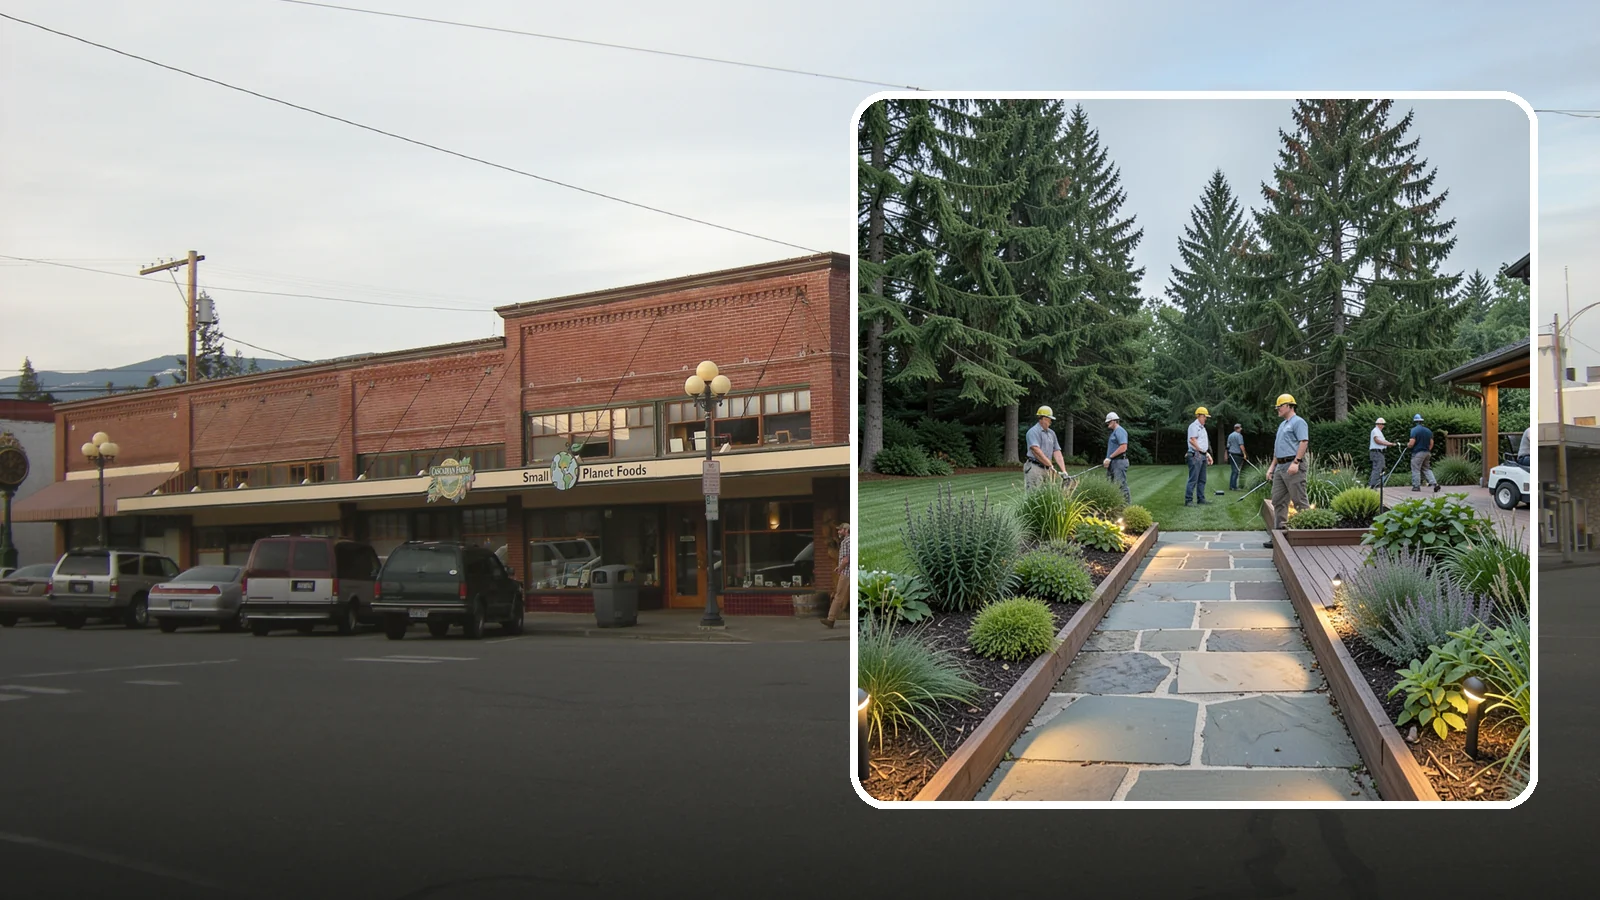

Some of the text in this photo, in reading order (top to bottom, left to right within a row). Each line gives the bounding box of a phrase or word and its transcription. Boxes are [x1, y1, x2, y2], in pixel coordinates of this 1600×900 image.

[523, 464, 647, 483] Small Planet Foods
